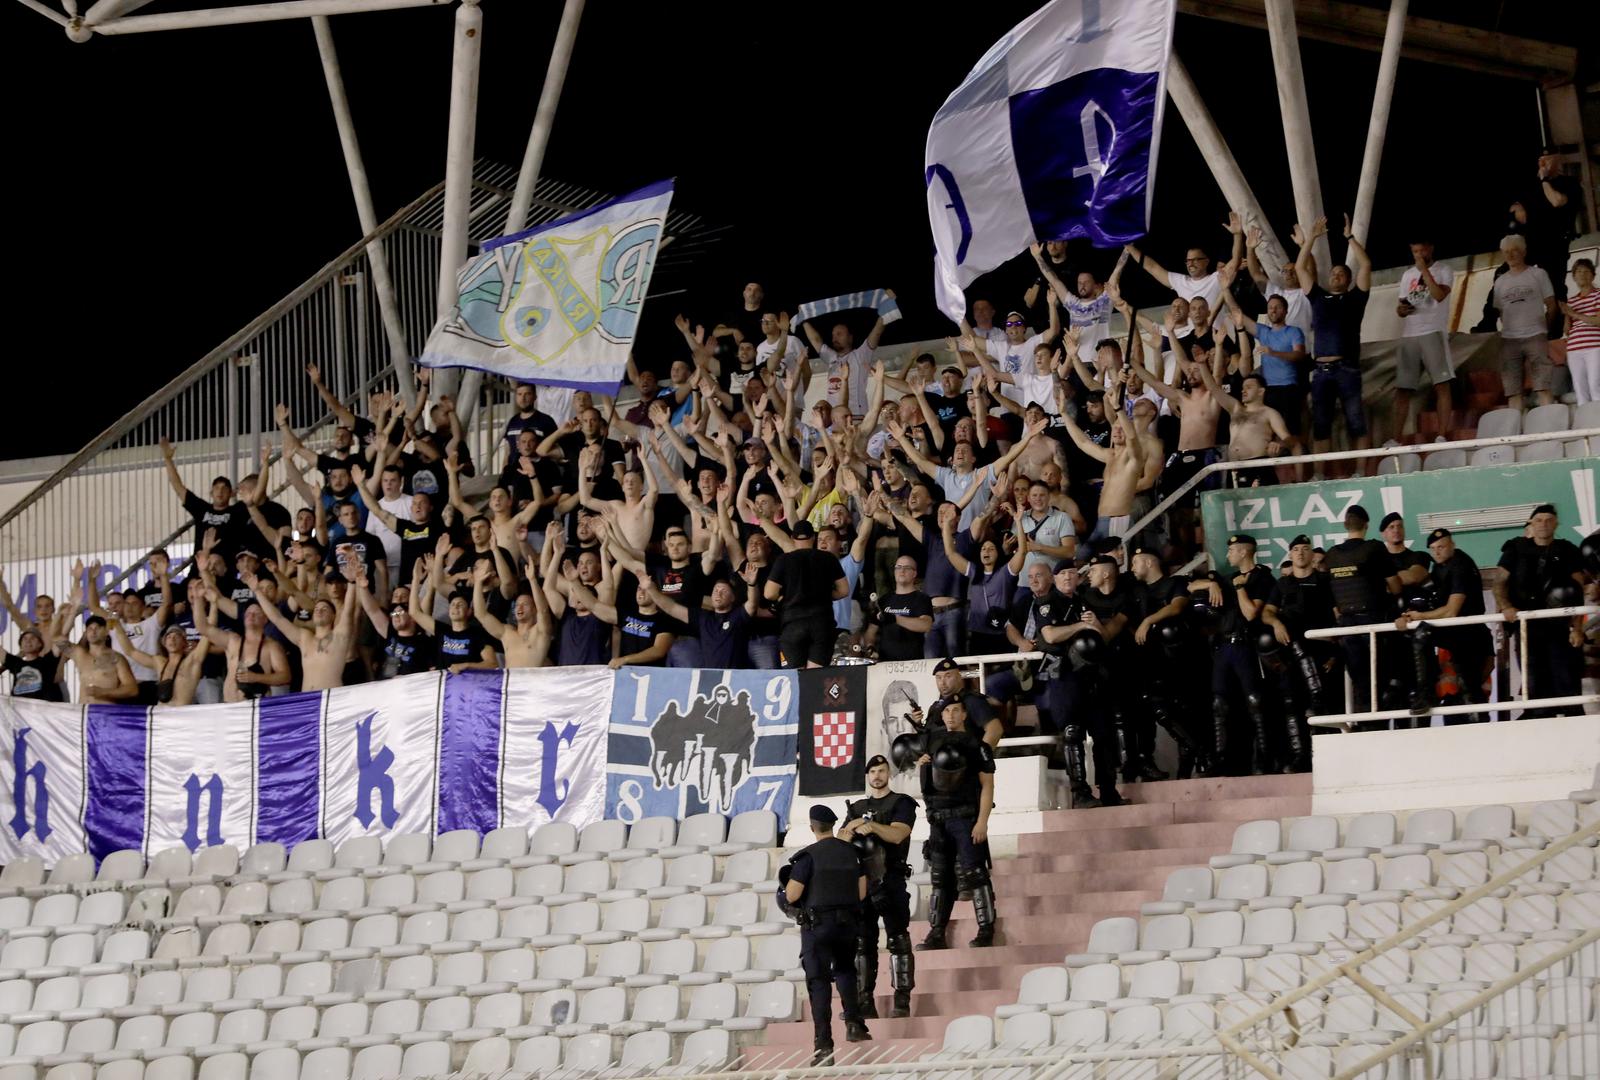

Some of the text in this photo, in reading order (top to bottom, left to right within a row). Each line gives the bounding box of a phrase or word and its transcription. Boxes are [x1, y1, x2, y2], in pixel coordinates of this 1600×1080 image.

[1224, 490, 1364, 531] IZLAZ
[763, 675, 792, 721] 9
[616, 779, 644, 825] 8
